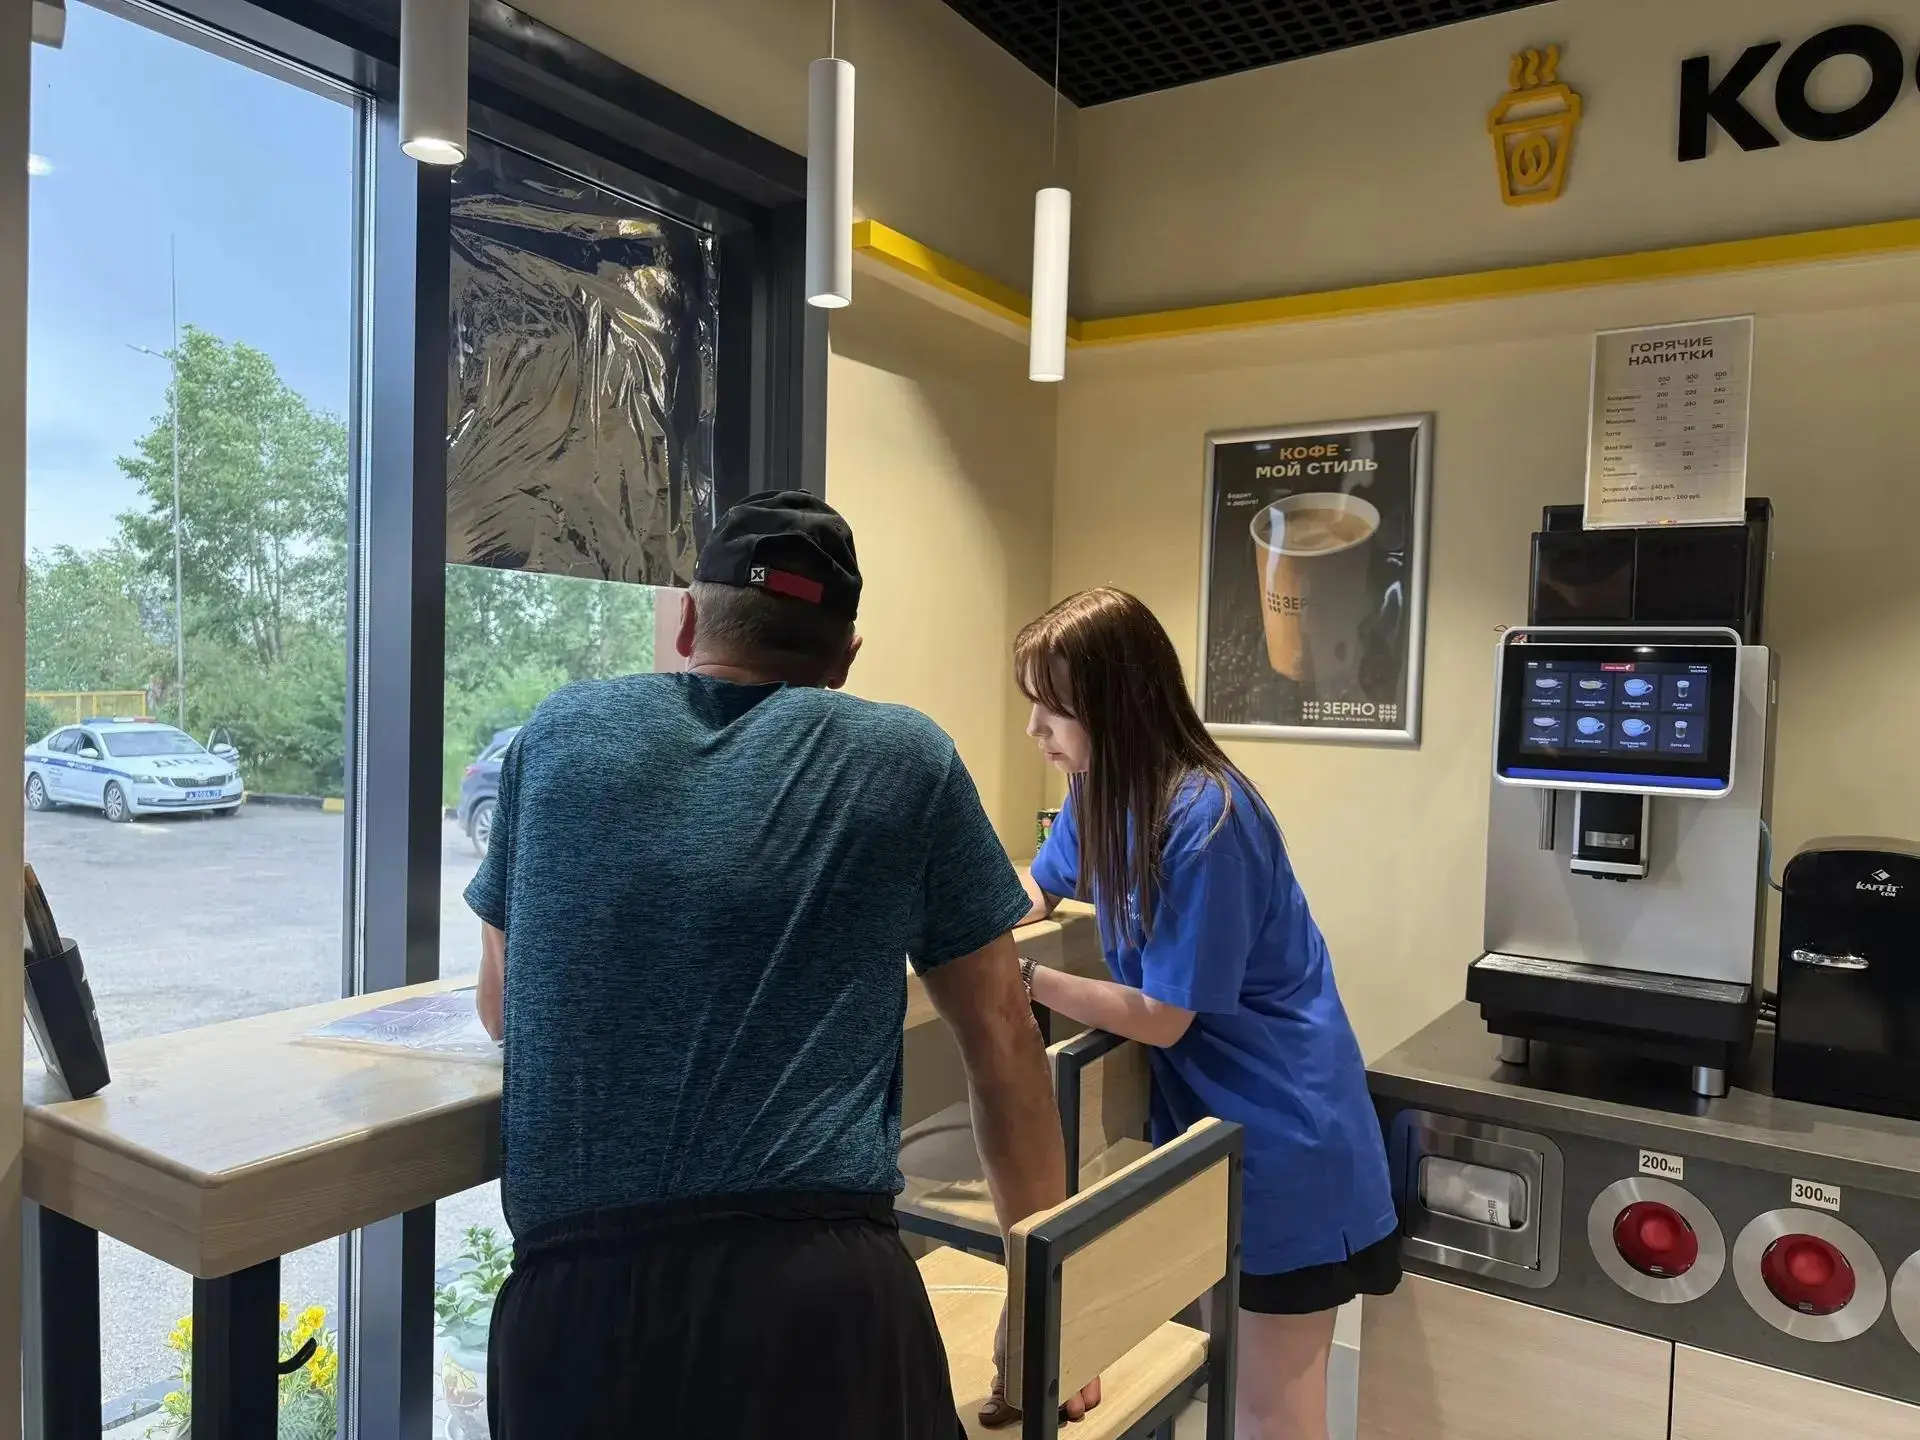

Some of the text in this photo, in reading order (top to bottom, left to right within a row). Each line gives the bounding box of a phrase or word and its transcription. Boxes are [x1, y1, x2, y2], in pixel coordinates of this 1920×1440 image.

[1678, 24, 1920, 162] КО
[1631, 336, 1713, 353] ГОРЯЧИЕ
[1628, 349, 1714, 366] НАПИТКИ
[1279, 443, 1338, 461] КОФЕ
[1255, 458, 1379, 479] МОЙ СТИЛЬ
[1283, 596, 1308, 610] ЗЕР
[1322, 702, 1376, 716] ЗЕРНО
[1641, 1155, 1681, 1175] 200мл
[1794, 1183, 1838, 1205] 300мл
